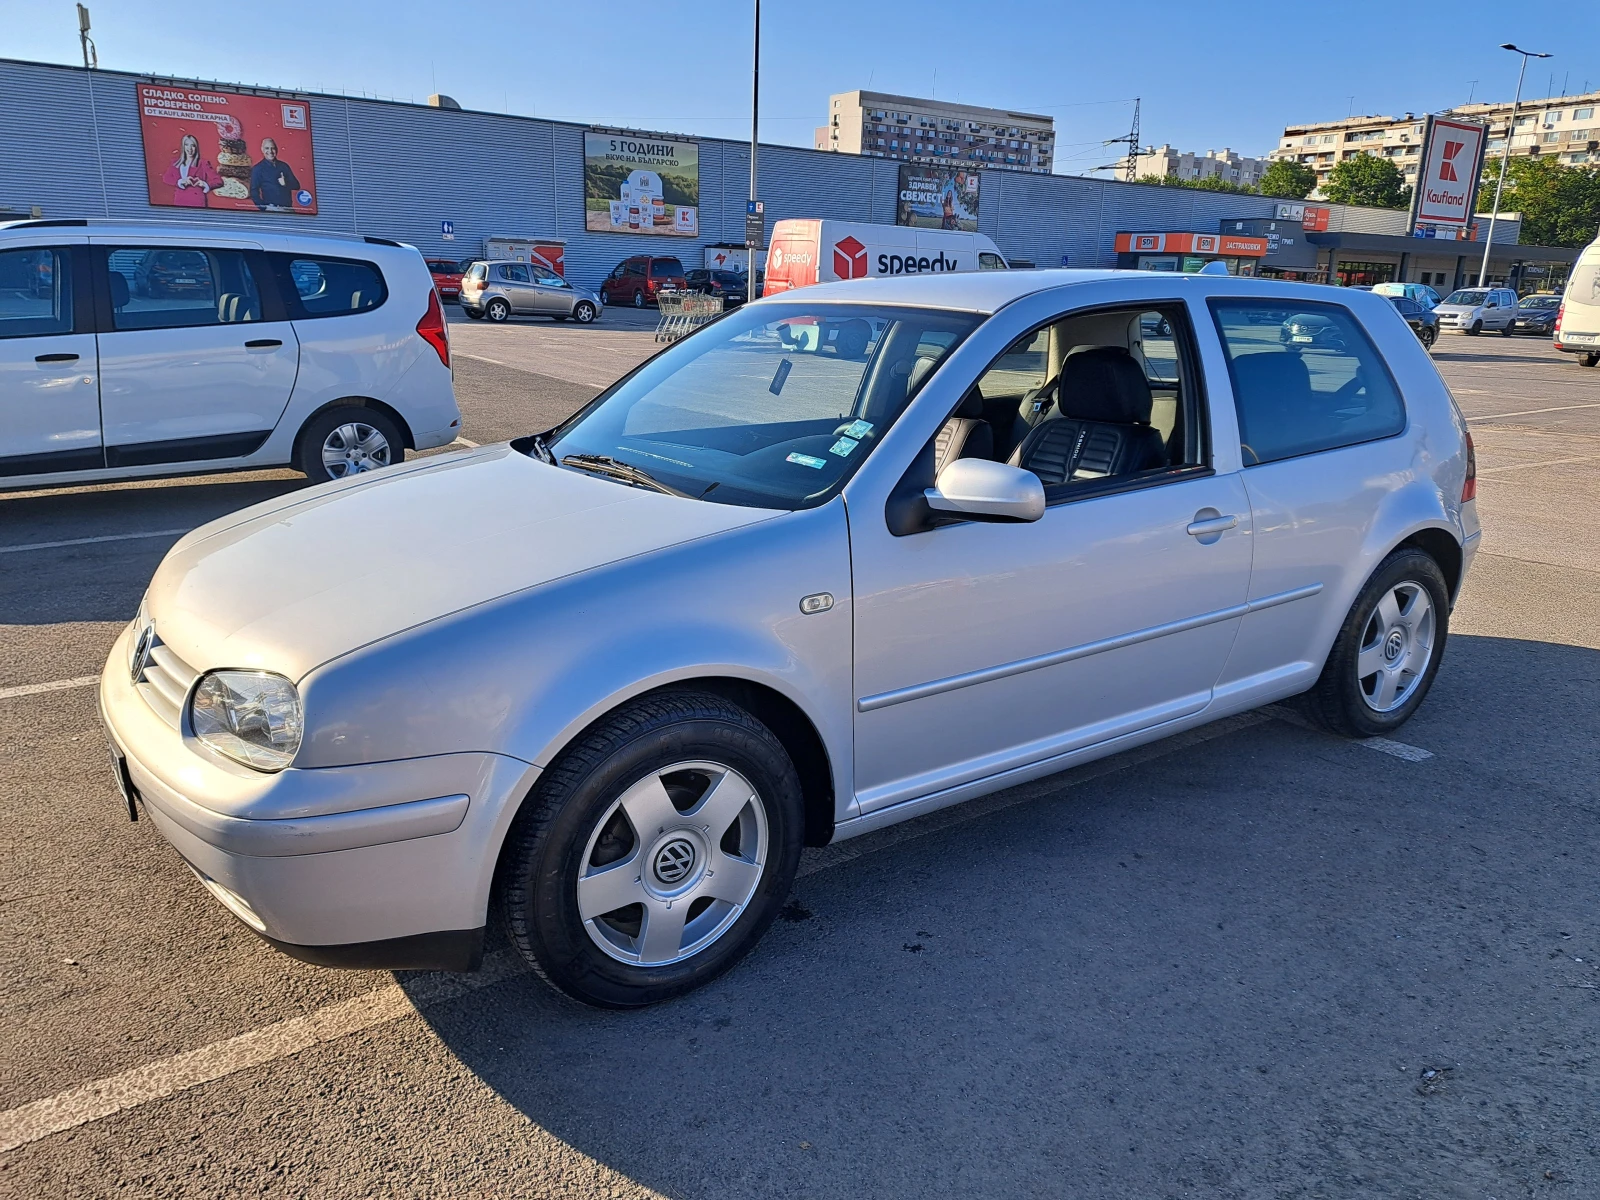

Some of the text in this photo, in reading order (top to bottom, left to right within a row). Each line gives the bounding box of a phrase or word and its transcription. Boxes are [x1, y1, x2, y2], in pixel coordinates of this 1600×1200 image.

[143, 88, 229, 104] СЛАДКО. СОЛЕНО.
[144, 98, 203, 111] ПРОВЕРЕНО.
[158, 109, 195, 119] KAUFLAND
[196, 113, 228, 121] ПЕКАРНА
[610, 140, 674, 157] 5 ГОДИНИ
[605, 153, 679, 167] ВКУС НА БЪЛГАРСКО
[1426, 188, 1464, 206] Kaufland
[1142, 238, 1153, 246] SDI
[1202, 239, 1211, 247] SDI
[1226, 241, 1261, 250] ЗАСТРАХОВКИ
[783, 250, 812, 267] speedy
[878, 251, 958, 275] speedy
[1073, 430, 1086, 459] FASHION
